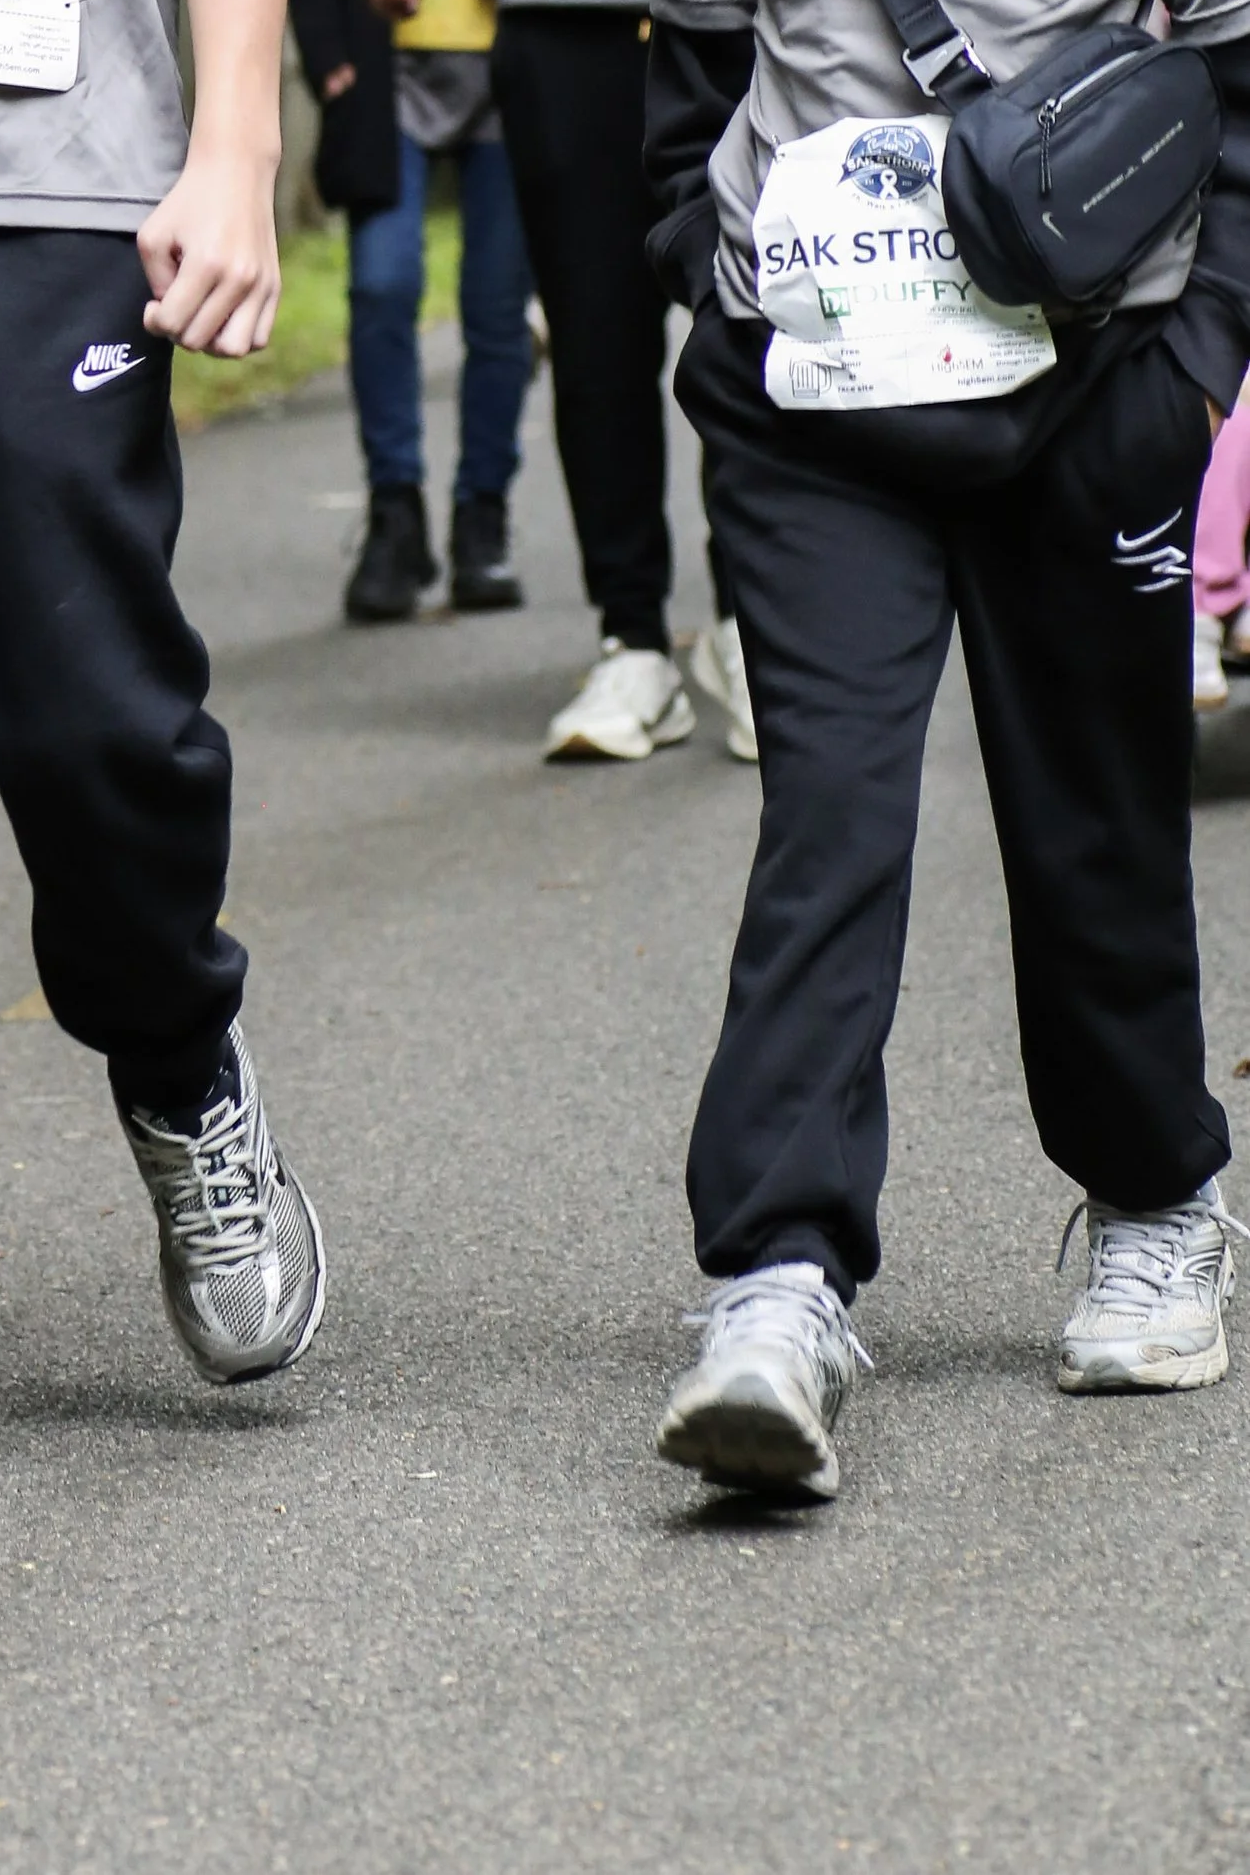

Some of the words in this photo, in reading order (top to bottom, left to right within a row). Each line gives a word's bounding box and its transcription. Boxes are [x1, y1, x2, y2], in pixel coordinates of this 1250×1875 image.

[765, 233, 840, 275] SAK
[852, 279, 972, 303] DUFFY
[83, 343, 131, 371] NIKE
